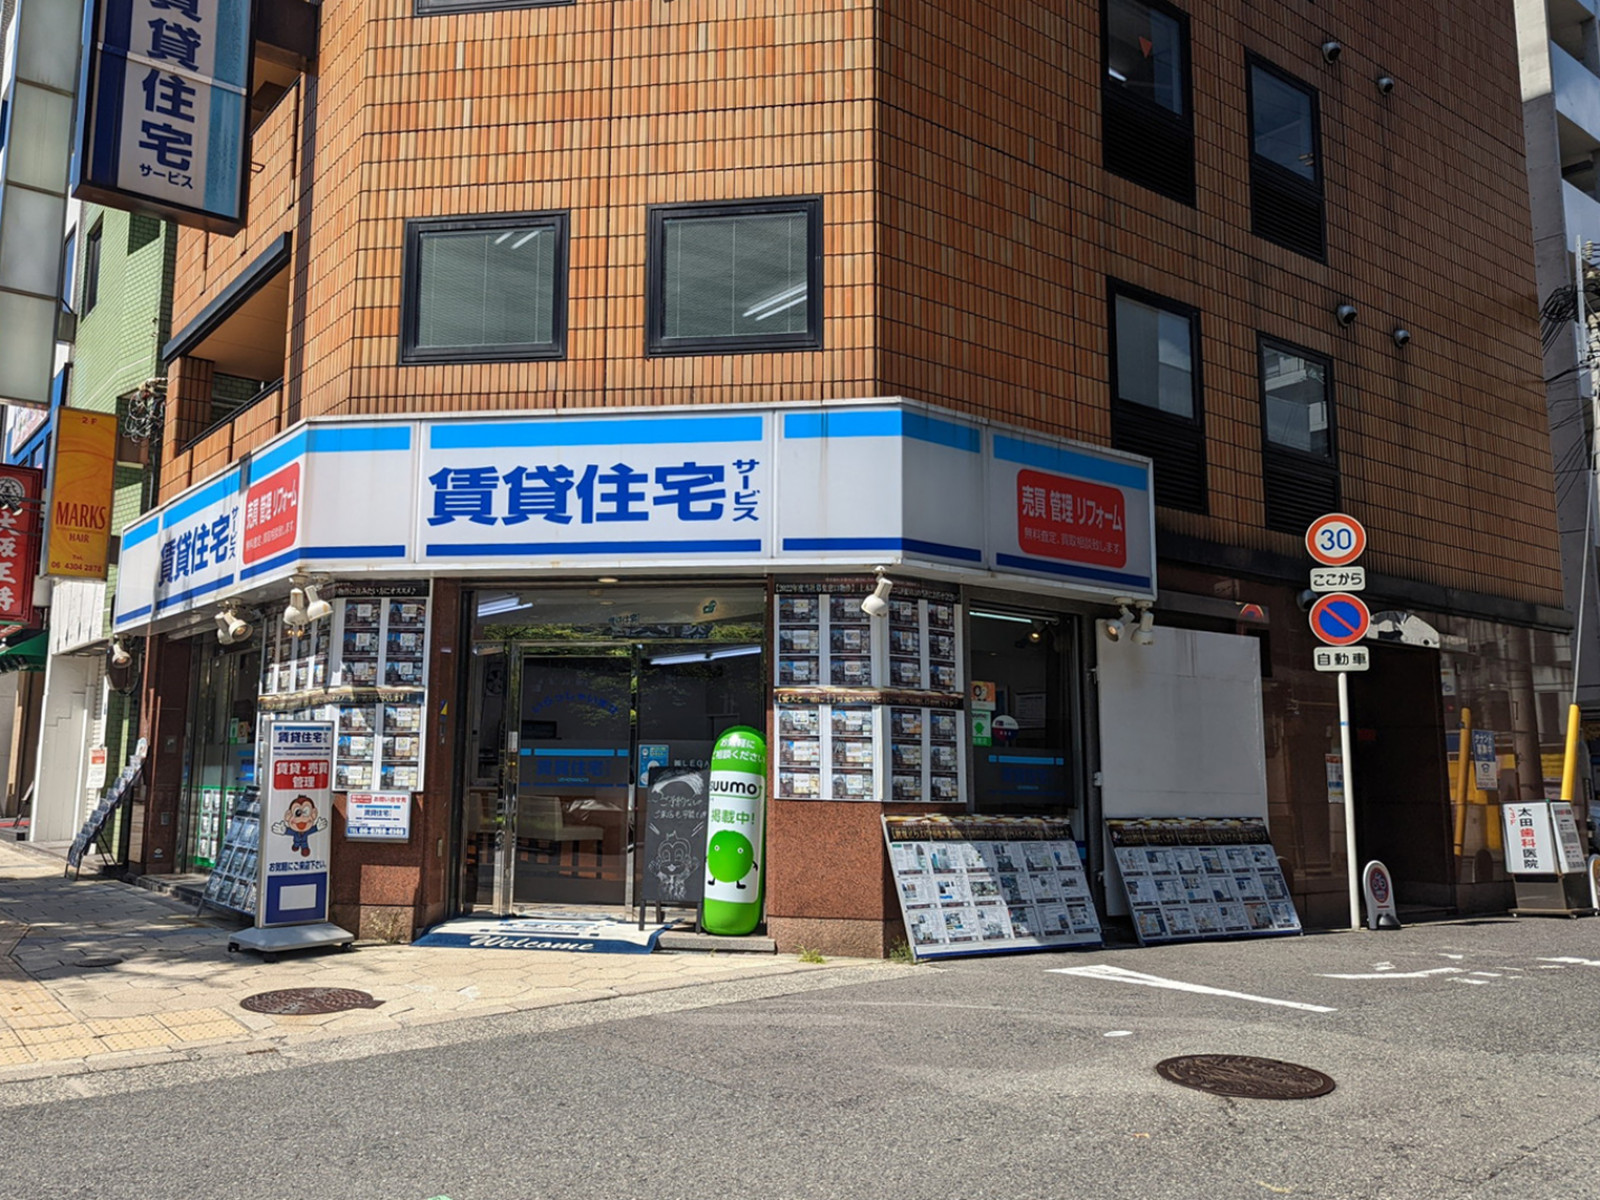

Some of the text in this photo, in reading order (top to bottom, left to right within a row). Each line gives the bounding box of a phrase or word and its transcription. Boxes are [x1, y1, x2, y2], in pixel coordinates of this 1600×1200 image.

[139, 163, 194, 190] サービス
[427, 458, 760, 527] 賃貸住宅 サービス
[56, 501, 107, 530] MARKS
[1022, 484, 1123, 532] 売買 管理 リフォーム
[69, 532, 90, 543] HAIR
[158, 506, 239, 588] 賃貸住宅 サービス
[1320, 528, 1352, 551] 30
[51, 561, 61, 569] 06
[1313, 573, 1363, 586] ここから
[1317, 652, 1367, 666] 自動車
[278, 732, 322, 743] 賃貸住宅
[276, 762, 328, 775] 賃貸・売買
[292, 776, 316, 788] 管理
[1518, 807, 1539, 869] 太田歯科医院
[469, 933, 595, 952] Welcome
